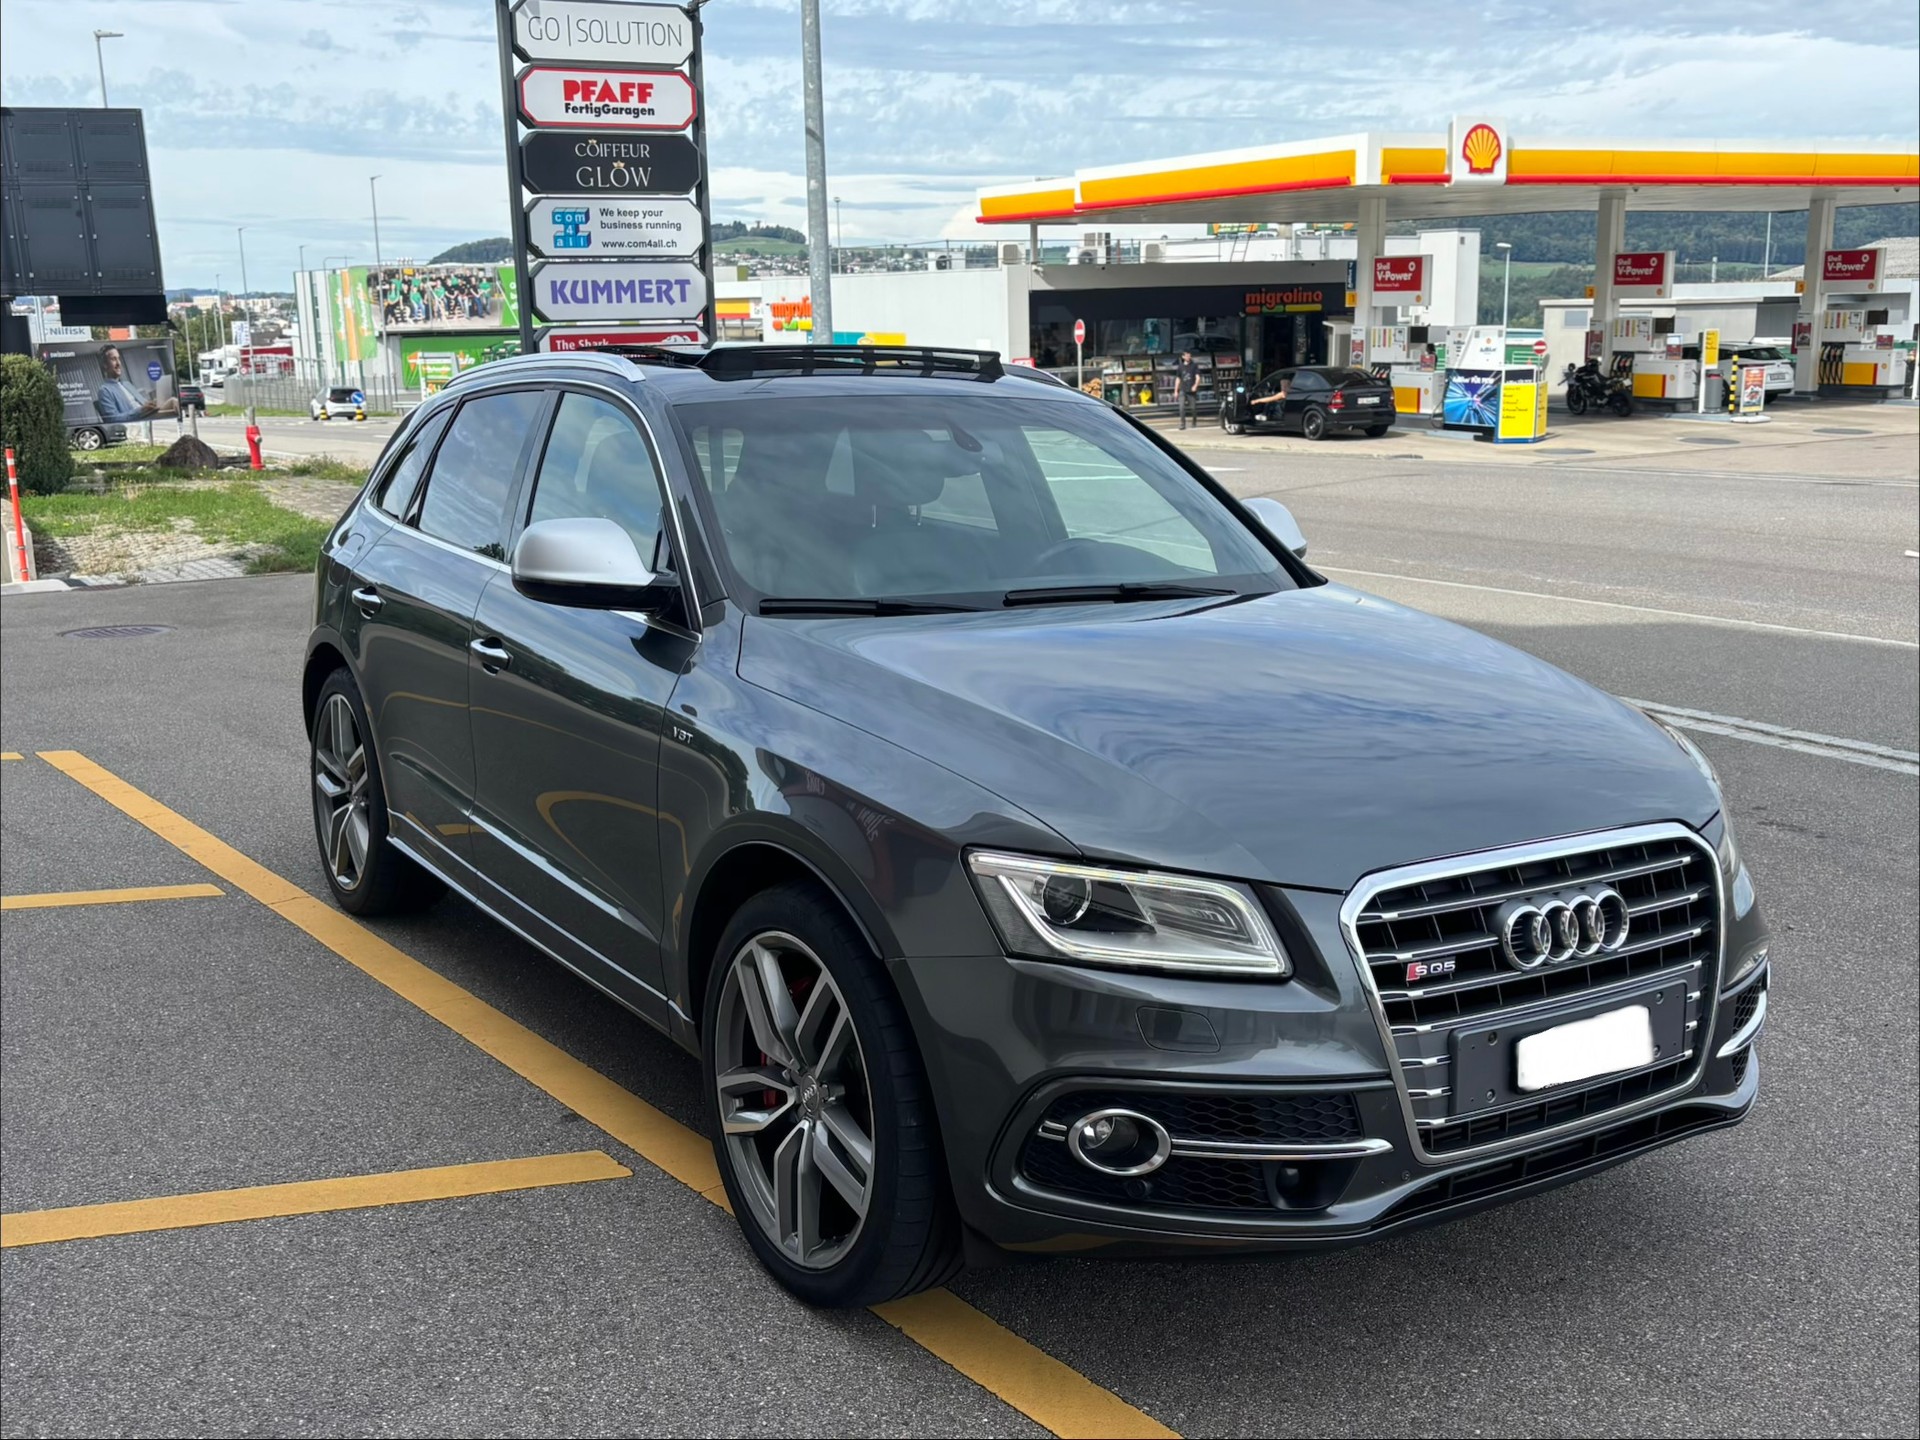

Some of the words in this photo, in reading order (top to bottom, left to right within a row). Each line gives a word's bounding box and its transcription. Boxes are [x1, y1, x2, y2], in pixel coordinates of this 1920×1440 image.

[528, 16, 560, 41] GO
[576, 18, 682, 47] SOLUTION
[563, 79, 654, 104] PFAFF
[564, 103, 655, 118] FertigGaragen
[575, 142, 650, 158] COIFFEUR
[576, 166, 651, 188] GLOW
[555, 213, 586, 223] com
[599, 208, 615, 217] We
[617, 208, 640, 220] keep
[641, 210, 664, 220] your
[566, 225, 573, 235] 4
[600, 220, 643, 230] business
[645, 221, 682, 231] running
[556, 236, 584, 247] all
[602, 240, 677, 248] www.com4all.ch
[1617, 266, 1654, 275] V-Power
[1827, 262, 1865, 271] V-Power
[1376, 271, 1413, 281] V-Power
[550, 279, 691, 306] KUMMERT
[1245, 287, 1322, 308] migrolino
[49, 327, 85, 336] Nilfisk
[556, 340, 576, 351] The
[1415, 960, 1456, 976] SQ5
